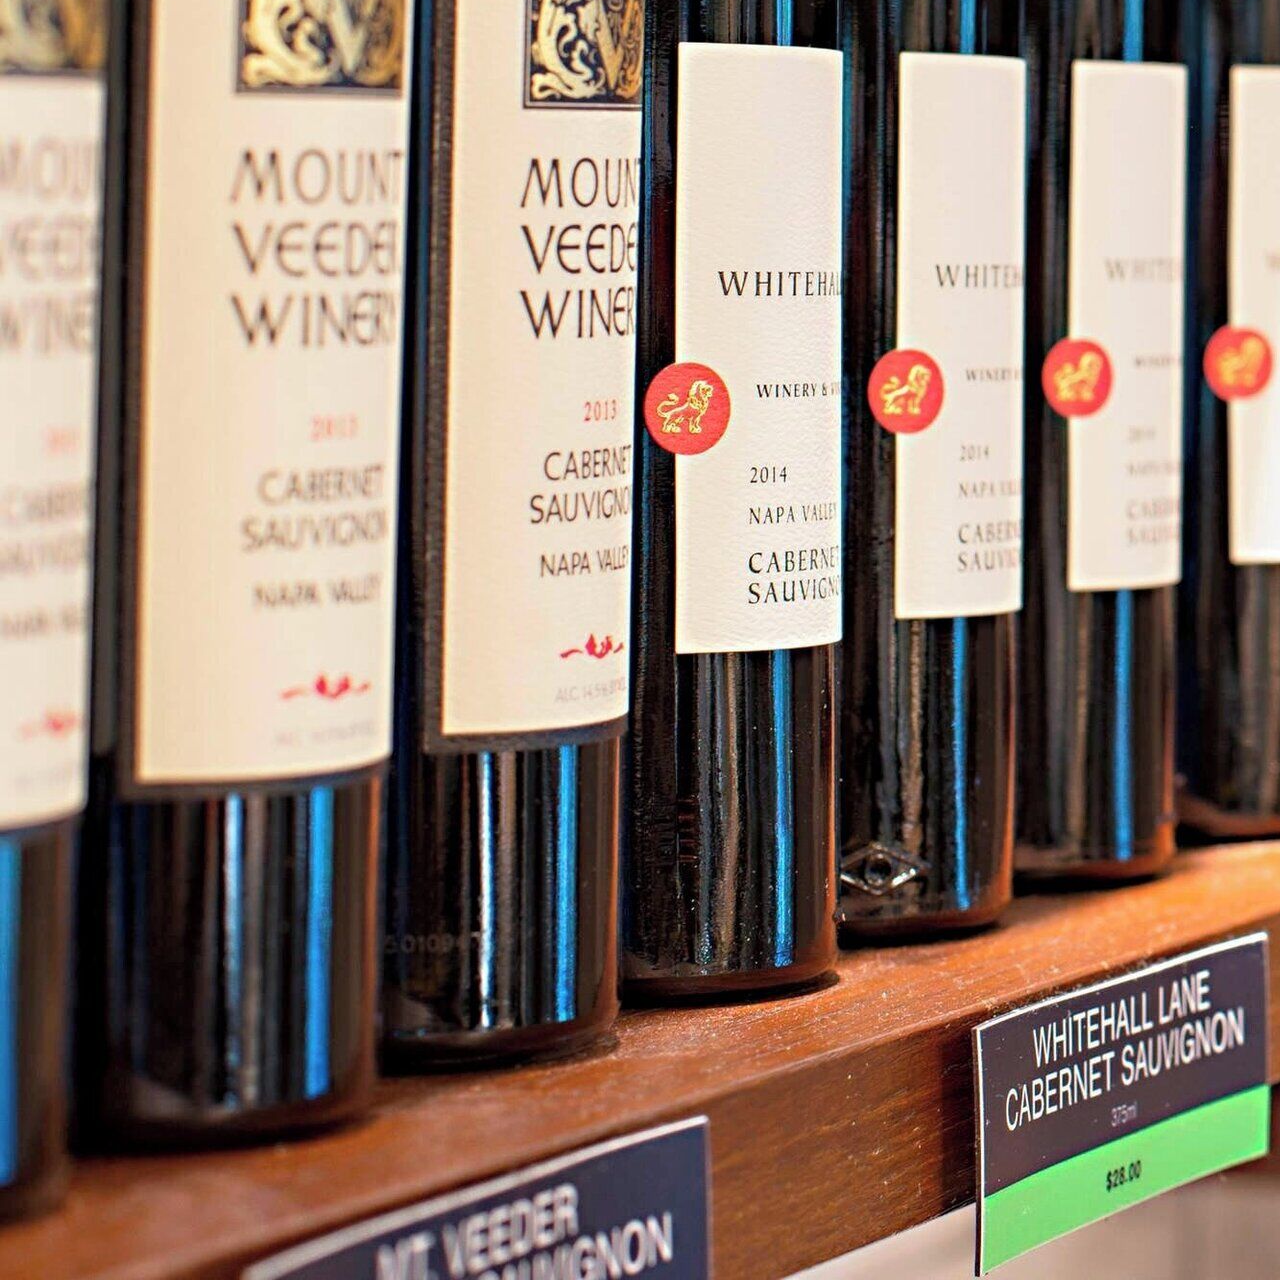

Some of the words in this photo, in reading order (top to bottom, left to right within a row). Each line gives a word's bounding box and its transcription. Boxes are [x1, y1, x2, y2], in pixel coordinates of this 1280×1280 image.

[230, 148, 403, 205] MOUNT
[521, 223, 638, 274] VEEDE
[756, 382, 818, 399] WINERY
[584, 400, 617, 422] 2013
[750, 466, 787, 483] 2014
[530, 486, 633, 525] SAUVIGNO
[749, 506, 796, 524] NAPA
[540, 552, 592, 578] NAPA
[748, 545, 839, 574] CABERNE
[1032, 991, 1154, 1068] WHITEHALL
[1158, 969, 1211, 1025] LANE
[1004, 1051, 1116, 1132] CABERNET
[1120, 1006, 1245, 1086] SAUVIGNON
[442, 1182, 580, 1278] VEEDER
[476, 1211, 674, 1280] VIGNON
